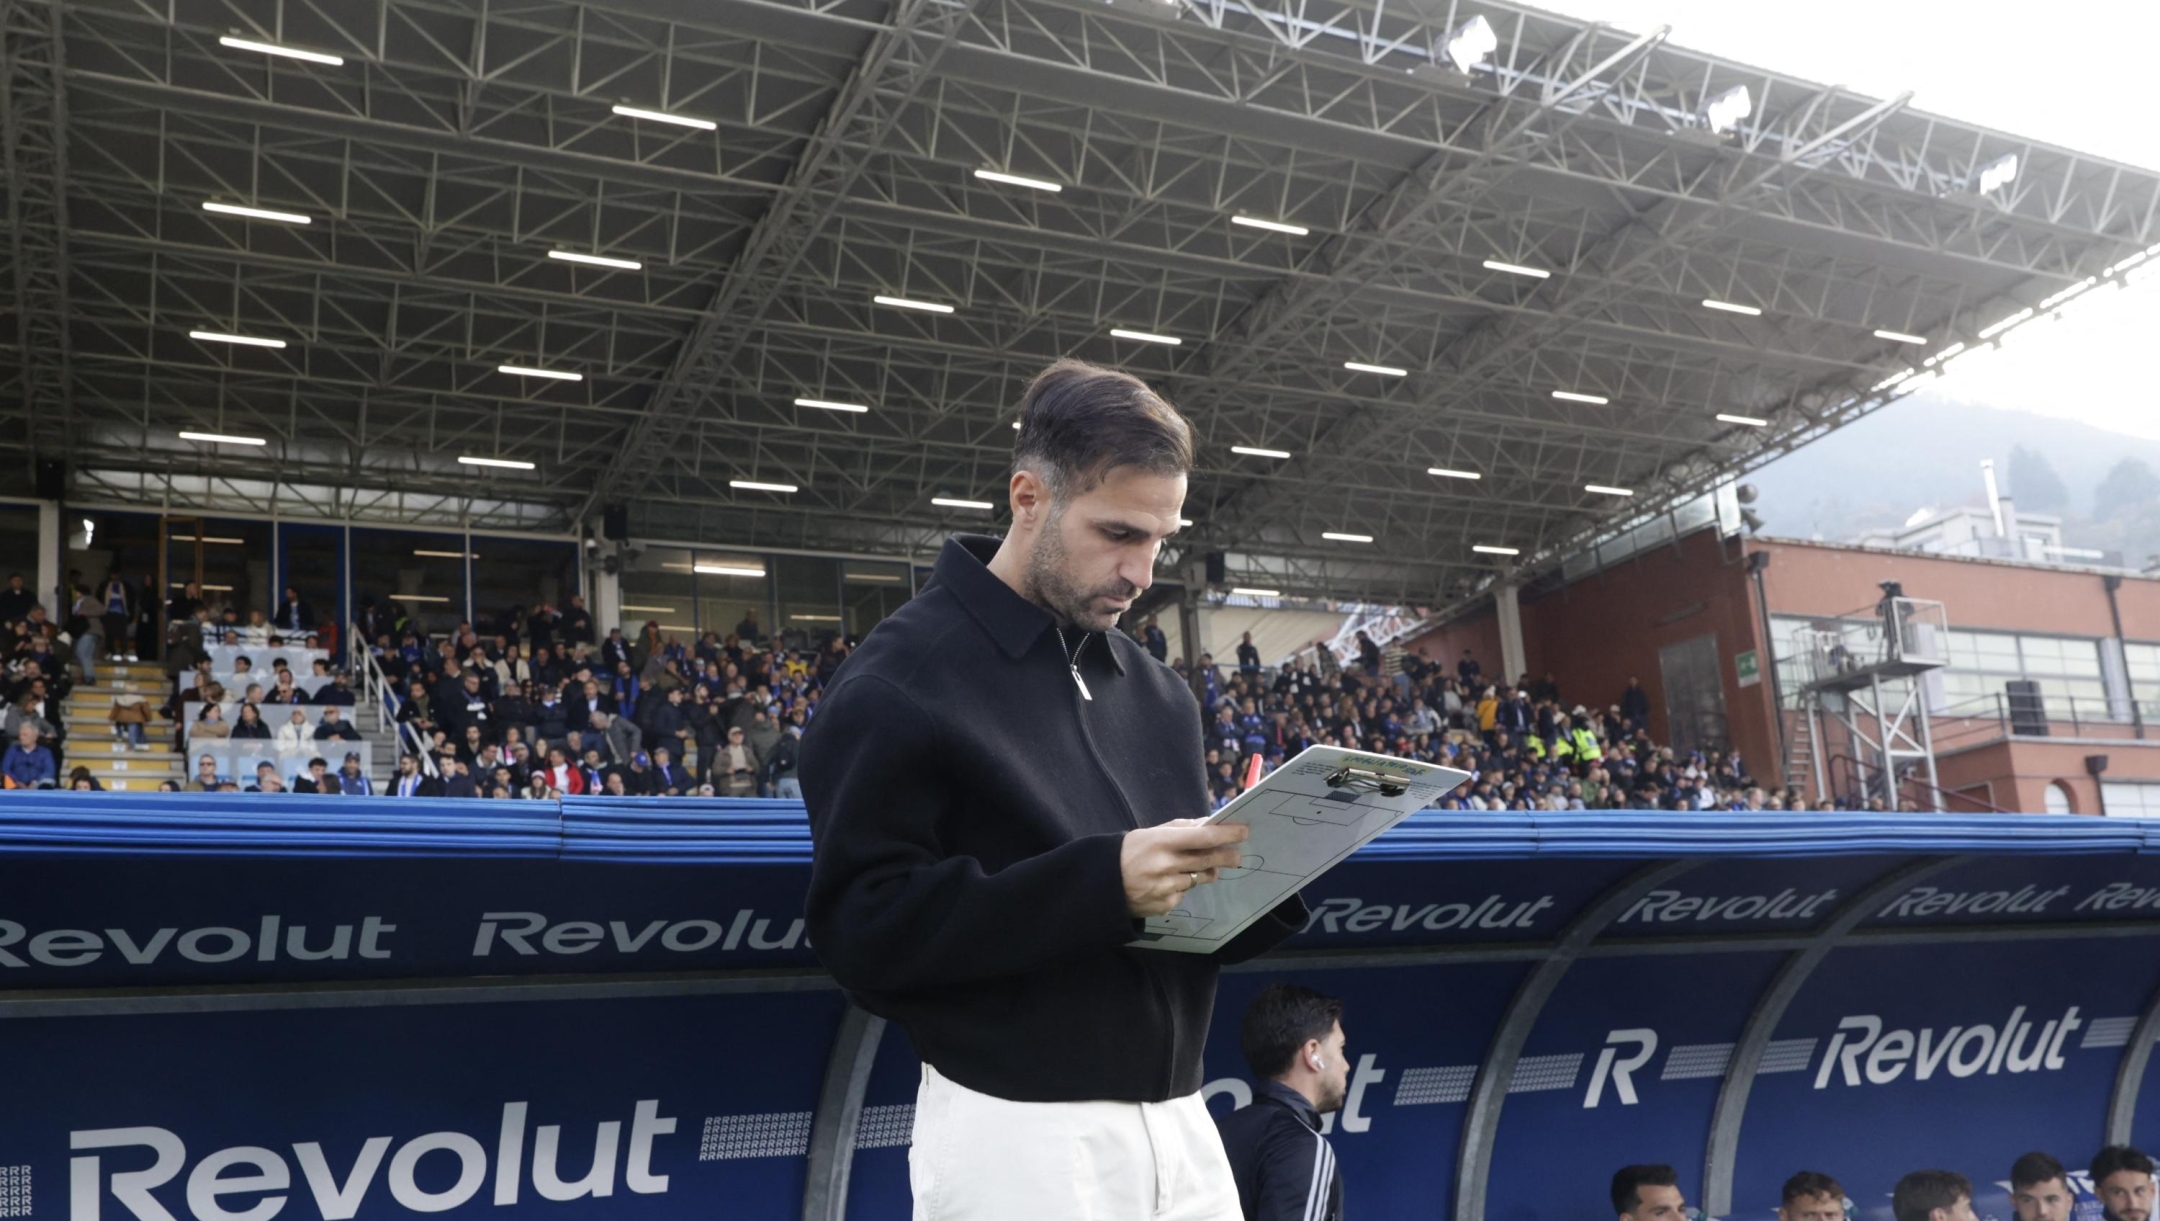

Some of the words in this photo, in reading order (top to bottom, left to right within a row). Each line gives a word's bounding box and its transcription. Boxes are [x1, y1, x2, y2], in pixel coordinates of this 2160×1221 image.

[1298, 894, 1555, 934] Revolut
[1617, 888, 1838, 923] Revolut
[1877, 884, 2071, 918] Revolut
[2074, 883, 2160, 911] Rev
[473, 909, 812, 957] Revolu
[1583, 1028, 1658, 1108] R
[1814, 1006, 2082, 1089] Revolut
[70, 1099, 677, 1221] Revolut
